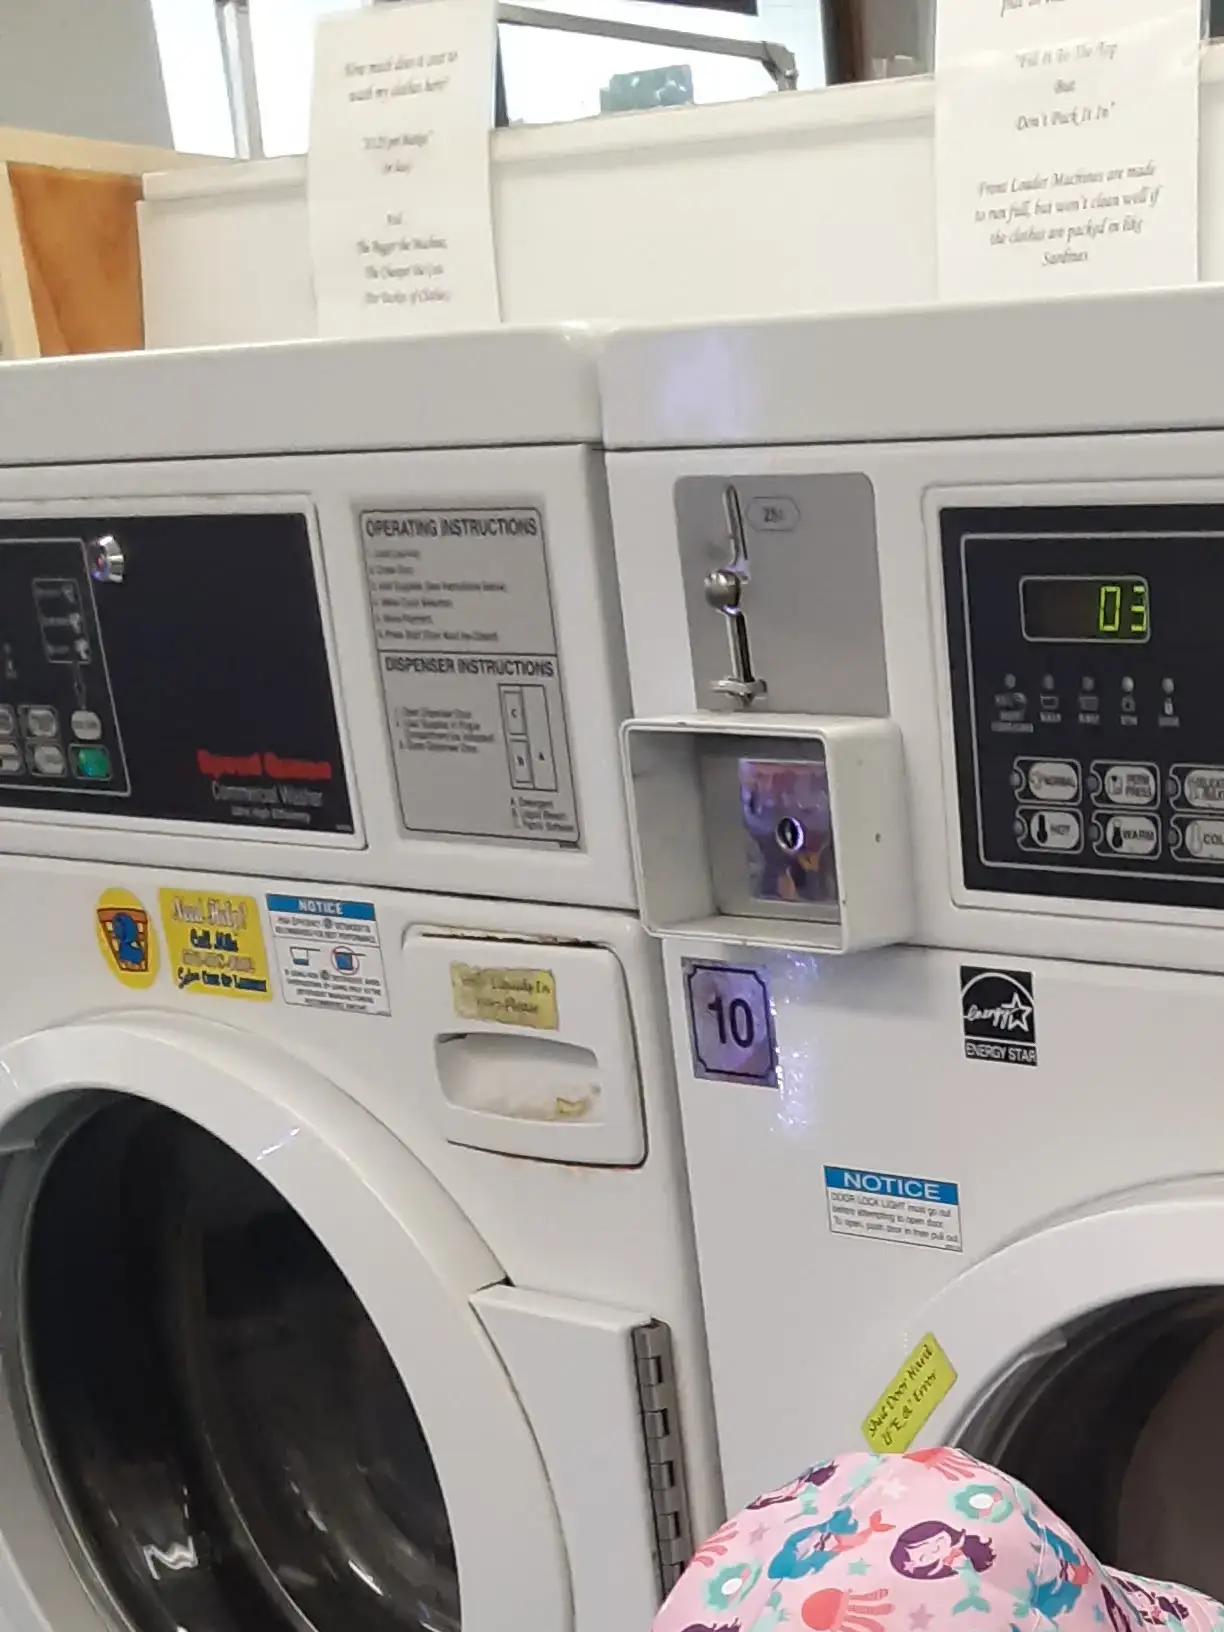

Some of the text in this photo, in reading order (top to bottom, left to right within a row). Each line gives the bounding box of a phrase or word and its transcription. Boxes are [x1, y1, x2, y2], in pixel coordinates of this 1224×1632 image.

[366, 518, 537, 537] OPERATING INSTRUCTIONS
[1100, 585, 1147, 631] 03
[385, 657, 555, 677] DISPENSER INSTRUCTIONS
[1123, 830, 1155, 842] WARM
[298, 899, 344, 915] NOTICE
[707, 987, 756, 1050] 10
[966, 1042, 1037, 1063] ENERGY STAR
[844, 1172, 941, 1200] NOTICE
